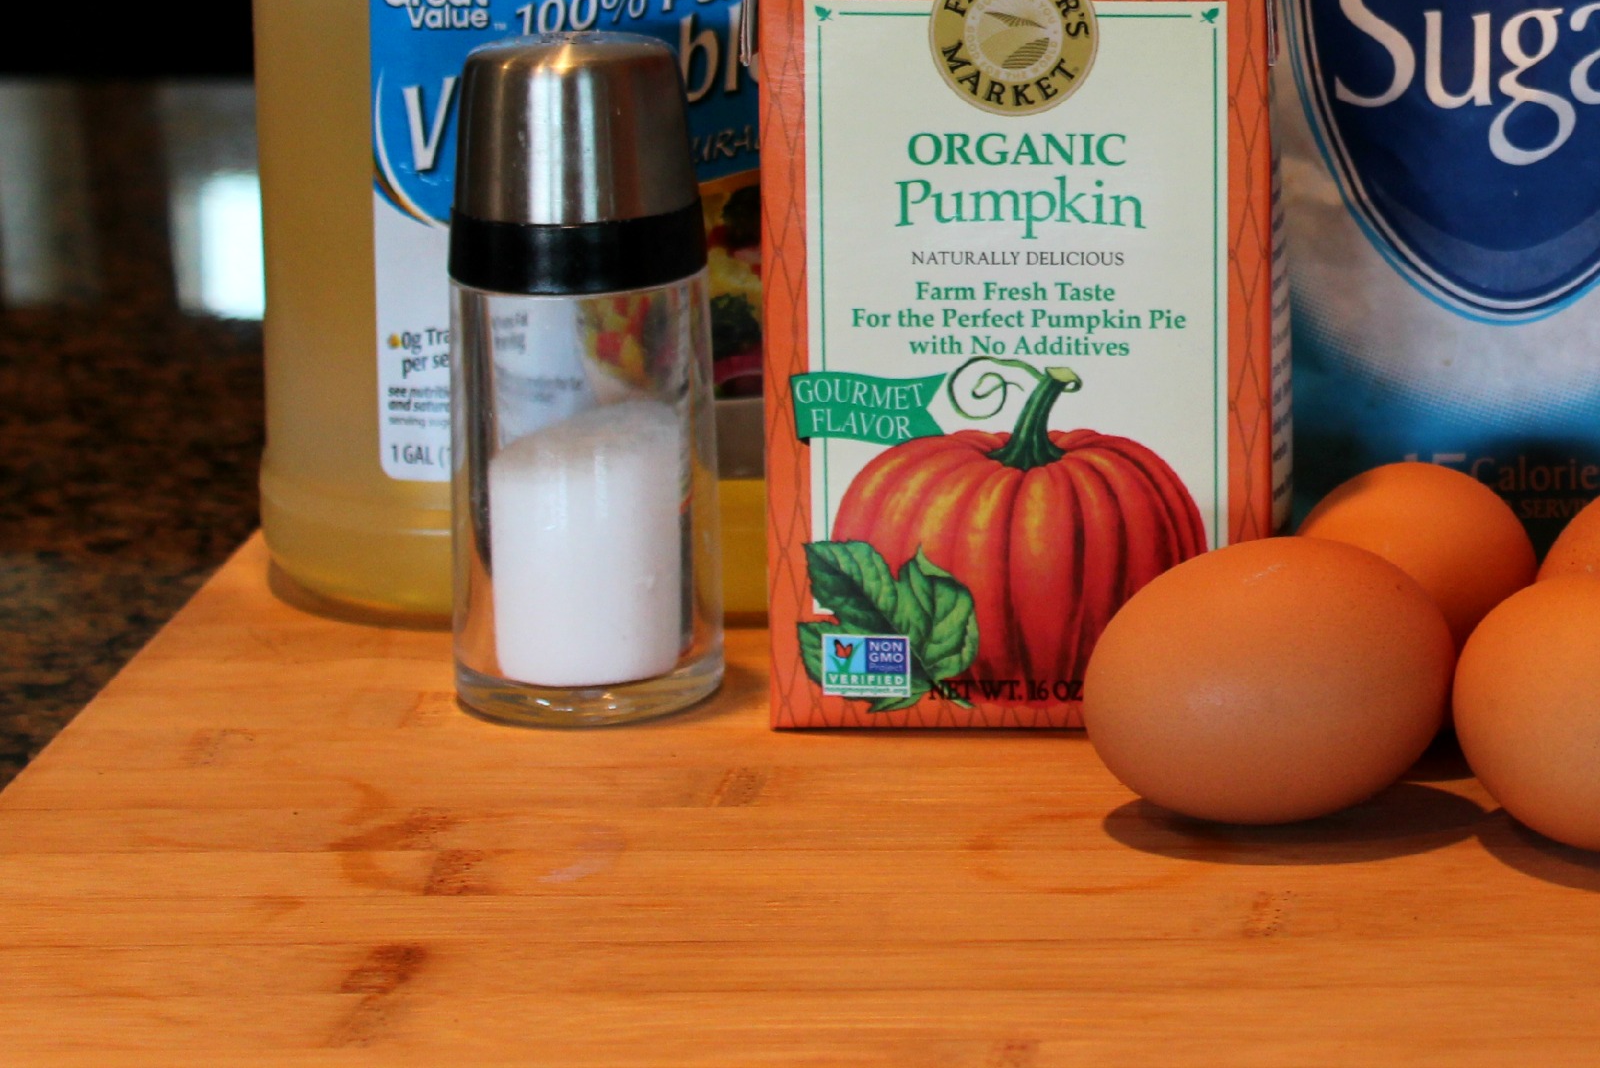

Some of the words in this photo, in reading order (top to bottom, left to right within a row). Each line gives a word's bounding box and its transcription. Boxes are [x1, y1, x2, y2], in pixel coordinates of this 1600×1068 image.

[406, 5, 488, 29] Value
[941, 39, 1076, 107] MARKET
[907, 132, 1127, 166] ORGANIC
[894, 174, 1147, 240] Pumpkin
[911, 250, 1020, 267] NATURALLY
[1026, 250, 1125, 267] DELICIOUS
[915, 281, 975, 301] Farm
[983, 280, 1048, 301] Fresh
[1054, 282, 1116, 302] Taste
[851, 308, 891, 328] For
[897, 308, 935, 328] the
[942, 307, 1025, 328] Perfect
[1031, 309, 1141, 334] Pumpkin
[1148, 310, 1187, 330] Pie
[909, 334, 963, 355] with
[970, 336, 1007, 356] No
[1013, 335, 1130, 357] Additives
[402, 357, 427, 380] per
[795, 378, 924, 410] GOURMET
[811, 408, 913, 439] FLAVOR
[403, 445, 433, 466] GAL
[1520, 499, 1590, 520] SERVI
[869, 641, 903, 652] NON
[869, 652, 905, 663] GMO
[829, 673, 905, 685] VERIFIED
[928, 679, 972, 701] NET
[979, 679, 1023, 701] WT.
[1028, 679, 1050, 701] 16
